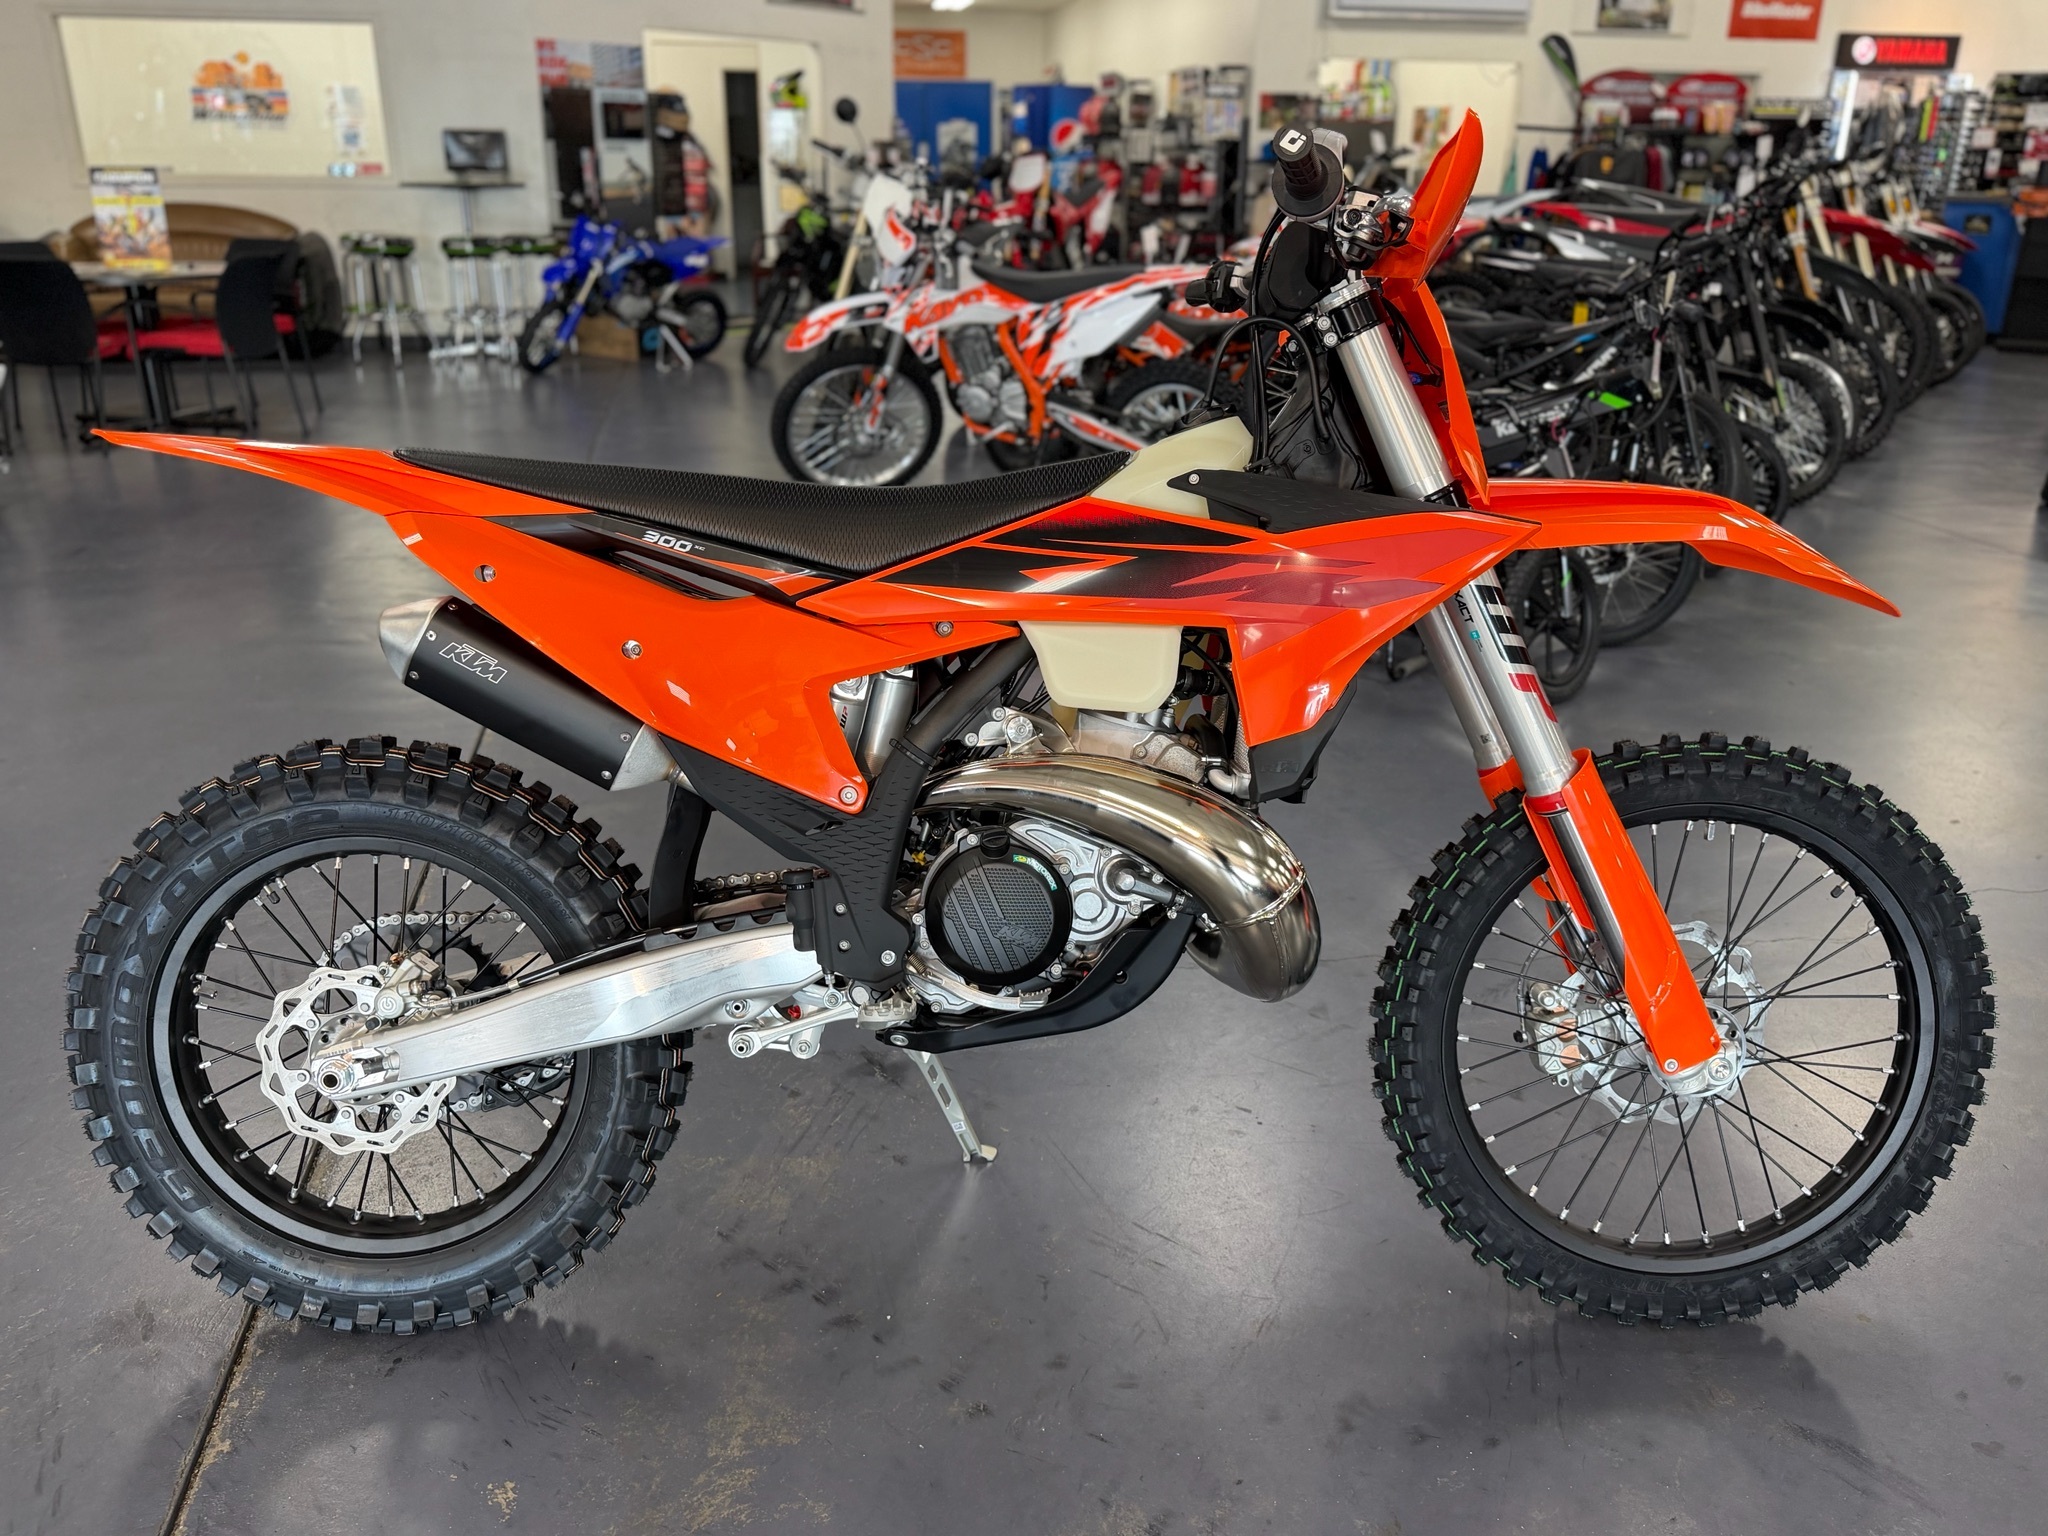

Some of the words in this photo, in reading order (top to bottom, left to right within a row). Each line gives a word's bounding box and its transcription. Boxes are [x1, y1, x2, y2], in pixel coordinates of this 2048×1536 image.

[1875, 37, 1947, 64] YAMAHA
[641, 530, 693, 553] 300
[439, 642, 508, 684] KTM
[384, 807, 536, 883] 110/100-18
[997, 924, 1041, 948] KTM
